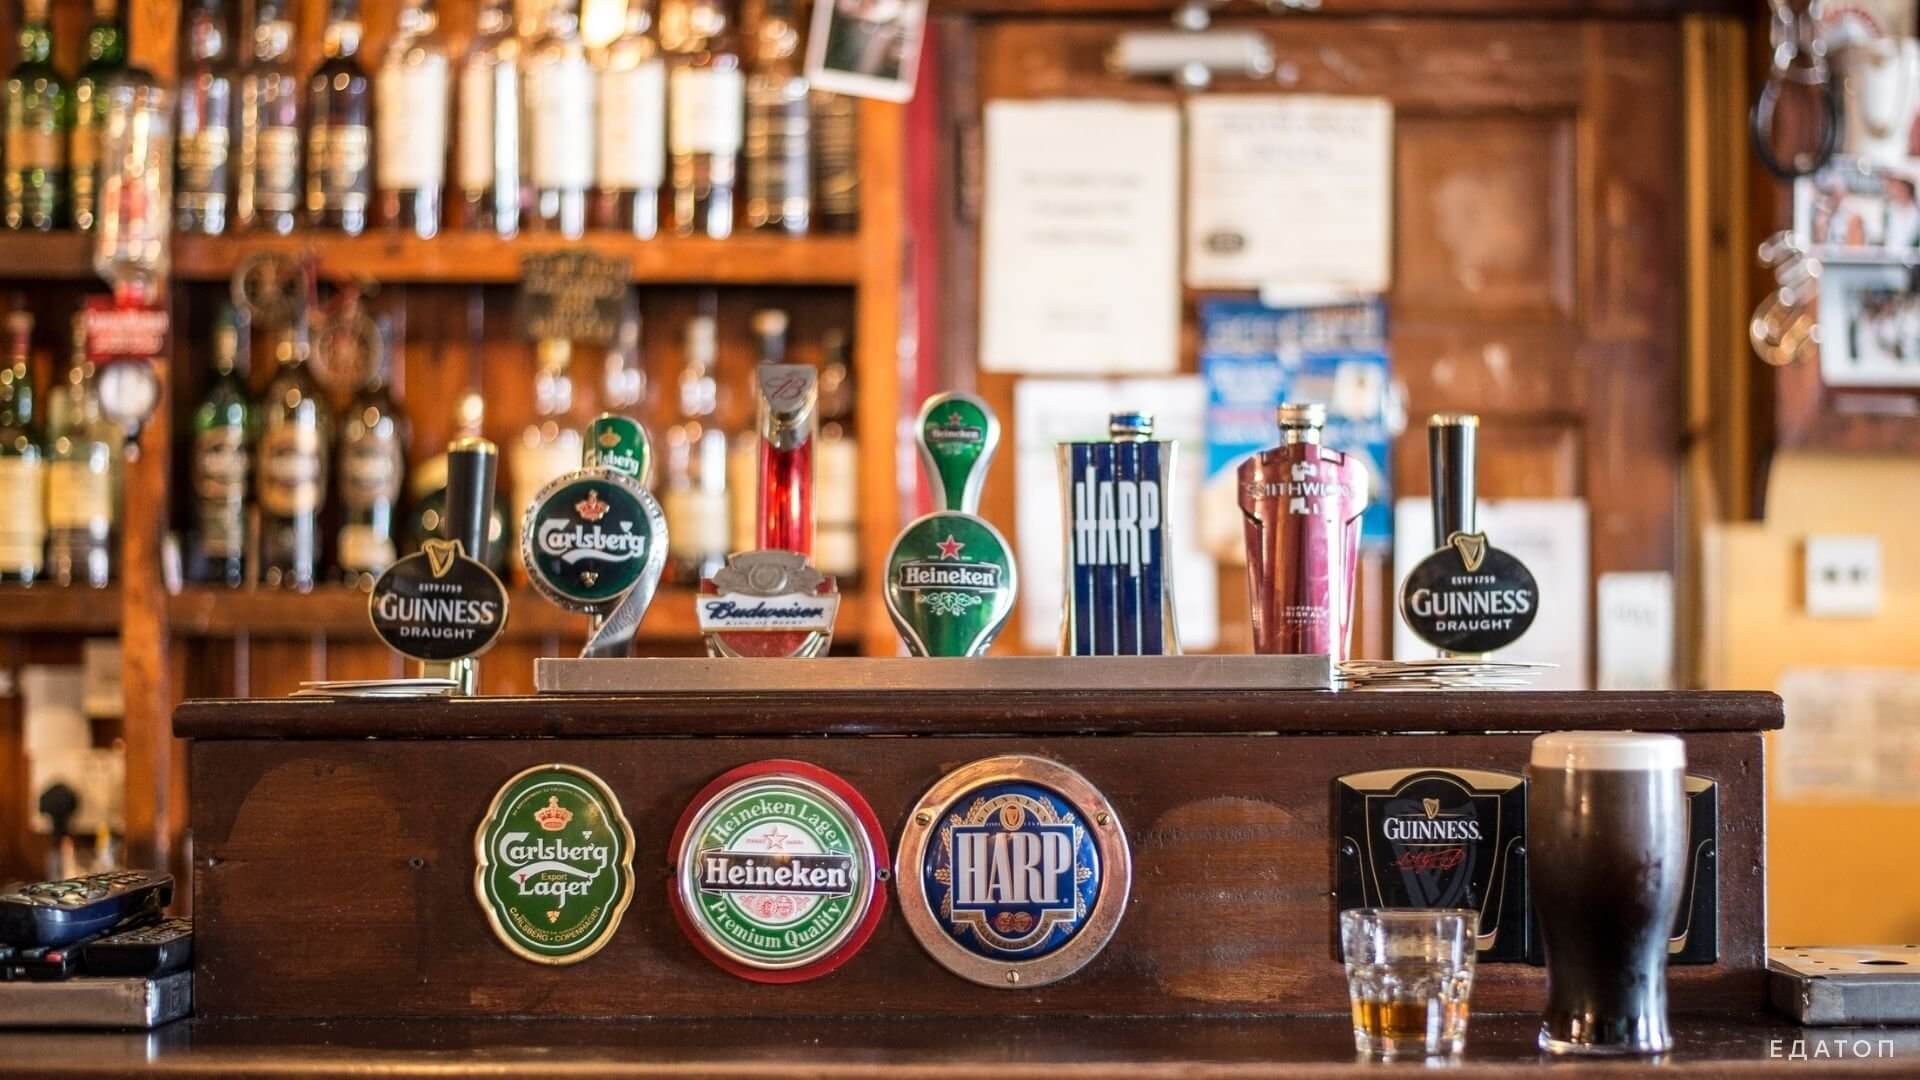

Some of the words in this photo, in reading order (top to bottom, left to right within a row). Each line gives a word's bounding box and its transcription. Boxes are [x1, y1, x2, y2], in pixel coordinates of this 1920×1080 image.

[538, 518, 646, 557] Carlsberg
[1075, 465, 1160, 577] HARP
[905, 567, 995, 586] Heineken
[378, 592, 495, 625] GUINNESS
[705, 600, 824, 620] Budweiser
[1410, 588, 1531, 617] GUINNESS
[400, 627, 476, 639] DRAUGHT
[1436, 619, 1513, 632] DRAUGHT
[710, 798, 796, 844] Heineken
[798, 805, 843, 849] Lager
[1383, 817, 1481, 840] GUINNESS
[499, 831, 608, 869] Carlsberg
[540, 872, 568, 882] Export
[705, 857, 848, 887] Heineken
[956, 831, 1072, 904] HARP
[517, 873, 594, 909] Lager
[509, 906, 549, 942] CARLSBERG
[709, 899, 781, 949] Premium
[784, 902, 843, 949] Quality
